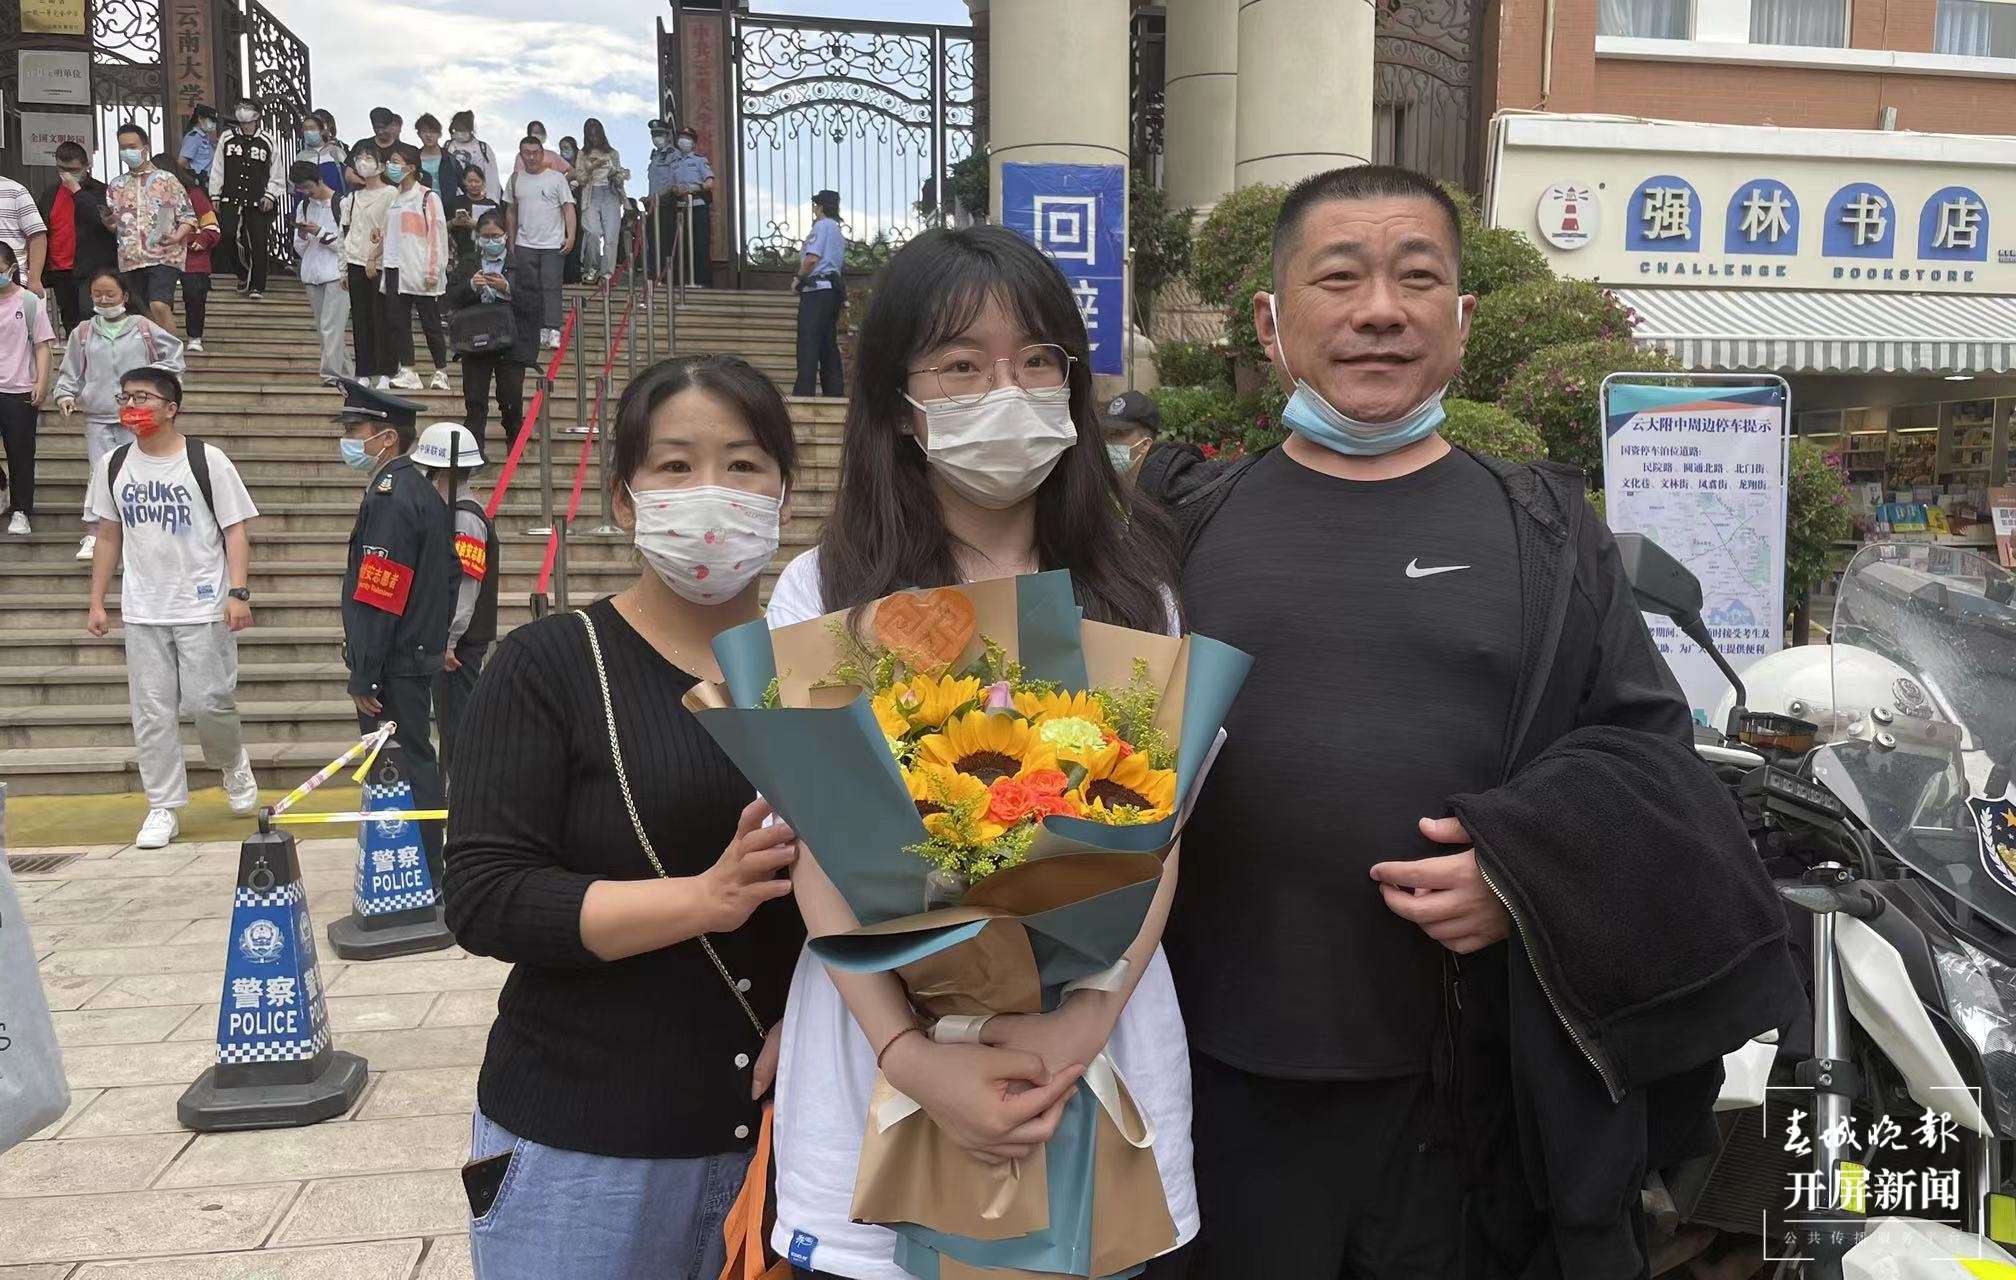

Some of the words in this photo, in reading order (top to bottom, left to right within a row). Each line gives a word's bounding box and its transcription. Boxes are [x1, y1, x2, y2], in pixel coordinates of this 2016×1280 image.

[1642, 185, 1985, 250] 强林书店
[1639, 260, 1789, 278] CHALLENGE
[1832, 265, 1976, 283] BOOKSTORE
[1632, 416, 1773, 433] 云大附中周边停车提示
[371, 846, 420, 873] 警察
[373, 869, 424, 893] POLICE
[231, 975, 297, 1009] 警察
[229, 1010, 298, 1036] POLICE
